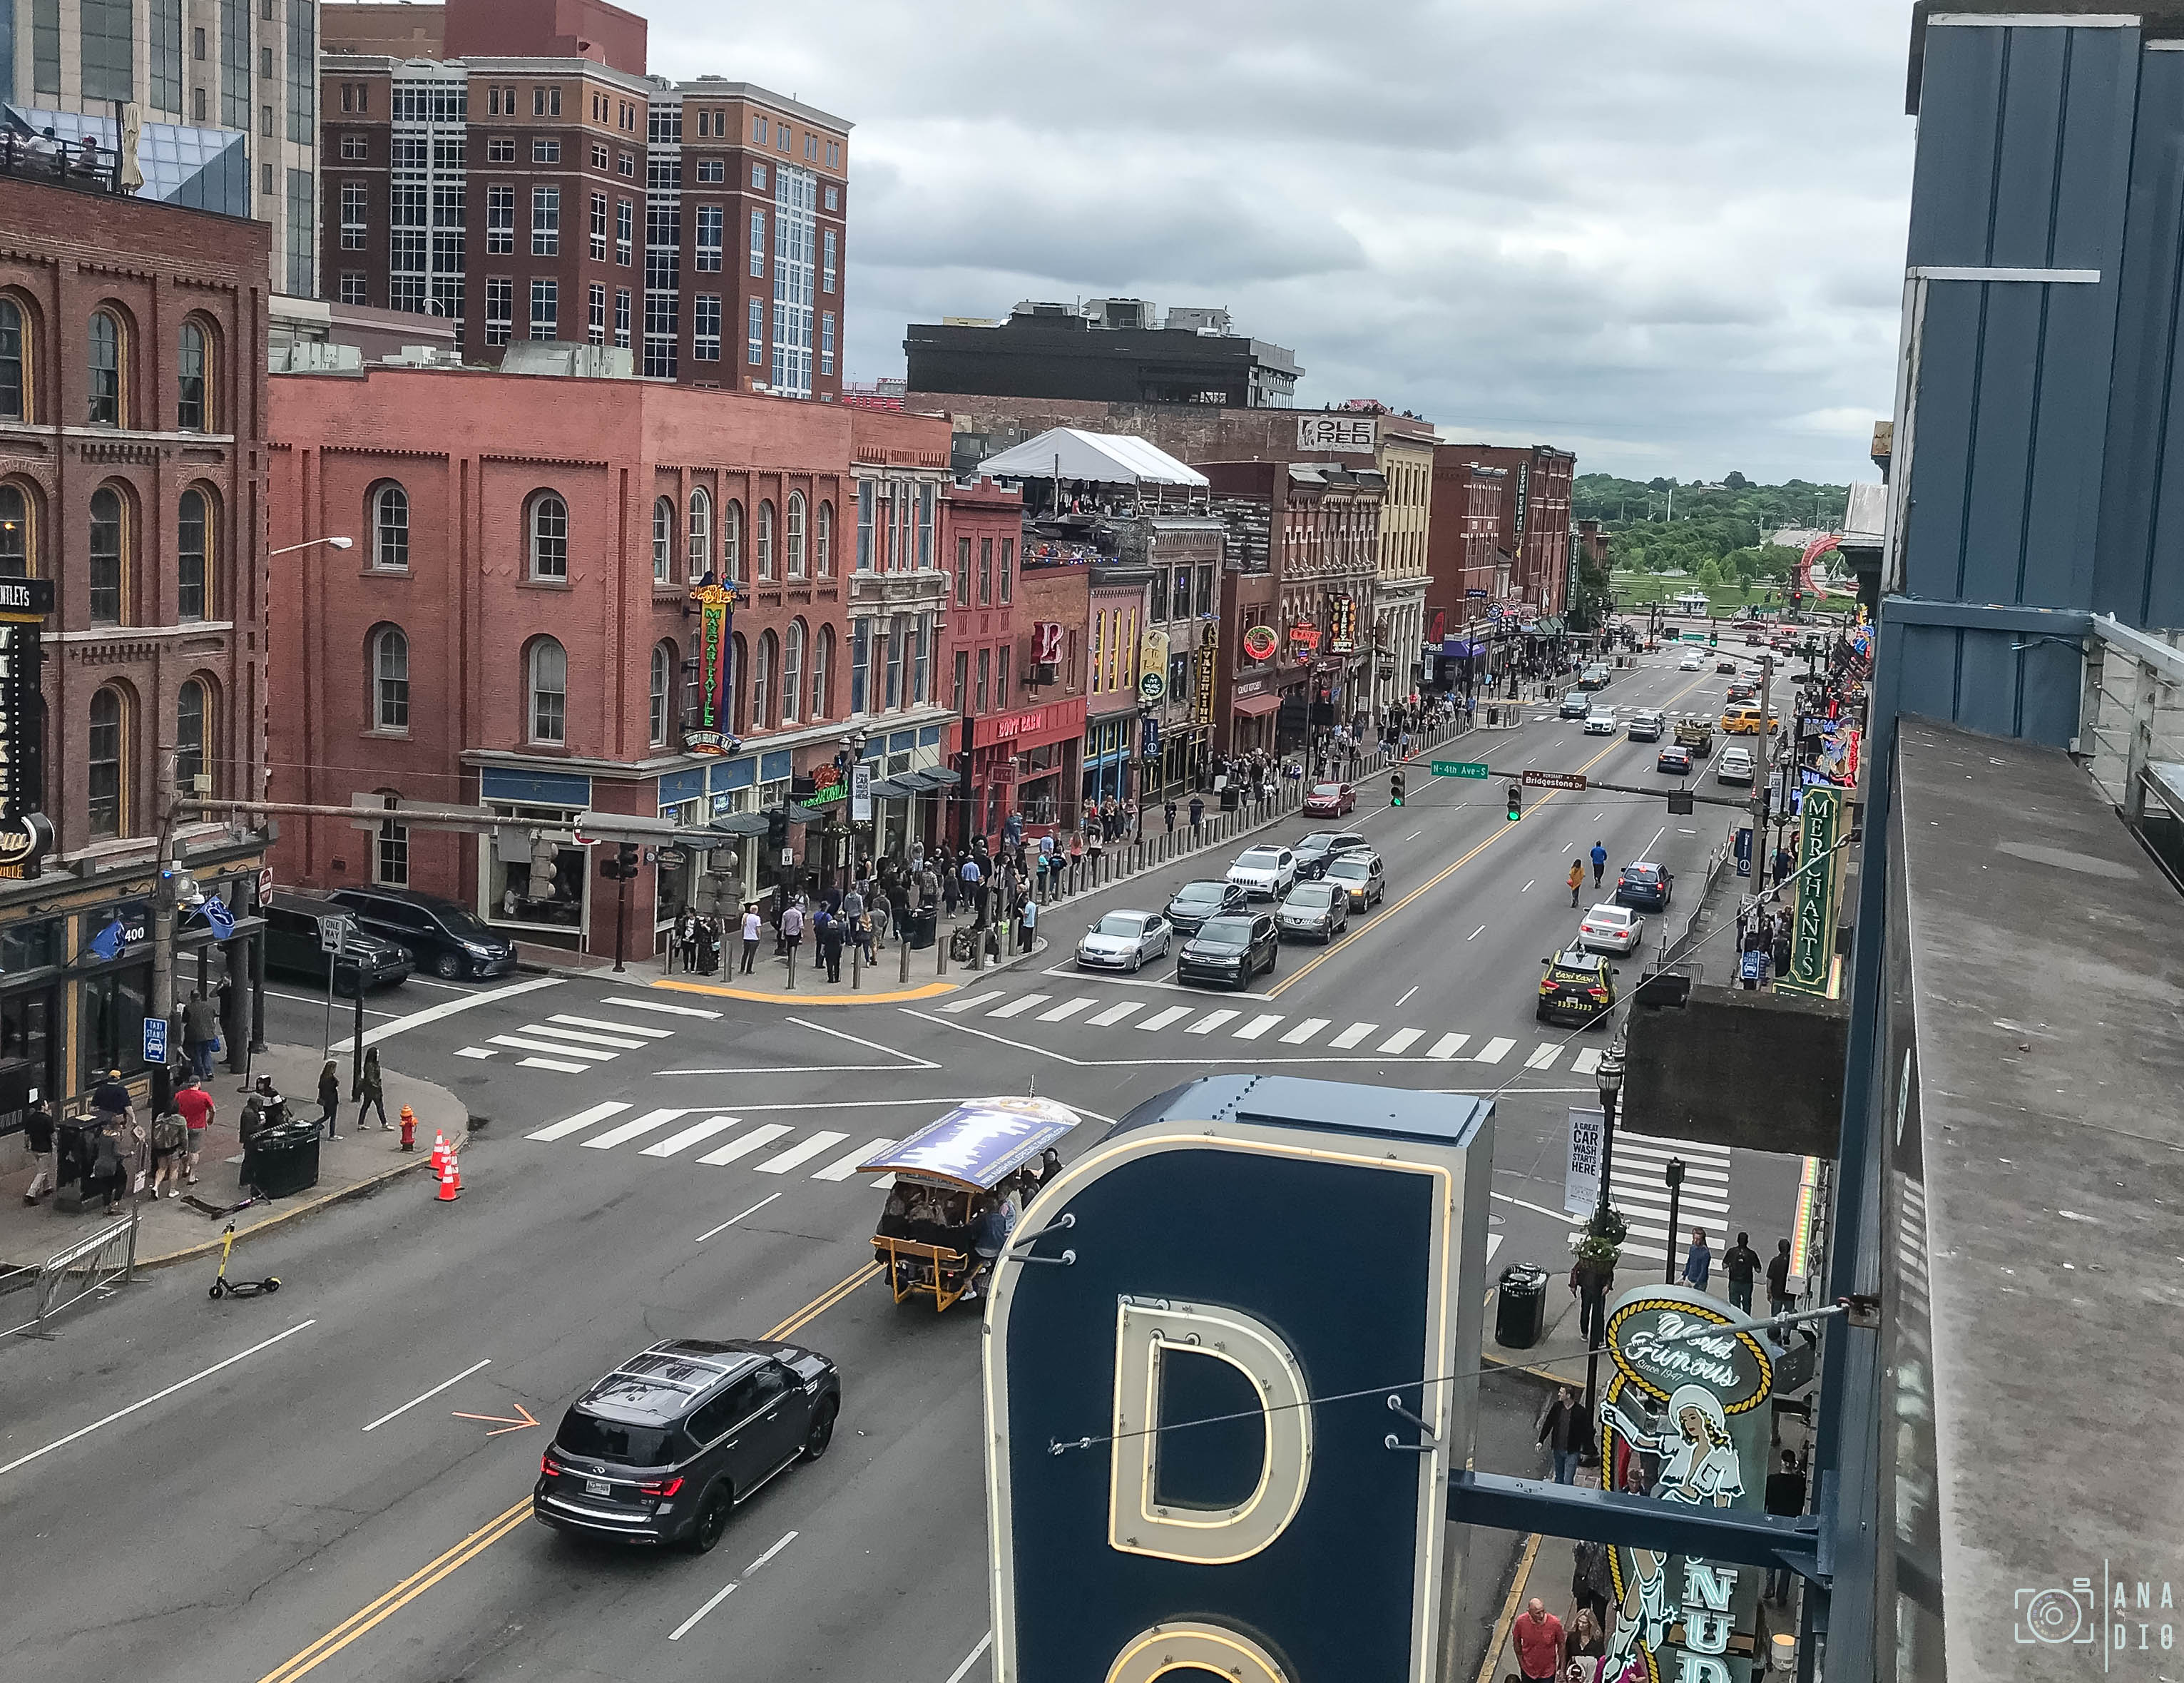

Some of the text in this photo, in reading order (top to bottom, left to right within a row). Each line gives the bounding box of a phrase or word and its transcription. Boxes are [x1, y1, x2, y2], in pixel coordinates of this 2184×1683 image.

[1317, 420, 1371, 433] OLE
[1317, 431, 1370, 444] RED
[1340, 599, 1349, 641] WHISKEY
[703, 609, 722, 727] MARGARITAVILLE
[1199, 651, 1212, 724] VALENTINE
[997, 717, 1020, 738] BOOT
[1526, 776, 1573, 788] Bridgestone
[1800, 796, 1830, 977] MERCHANTS
[124, 927, 145, 942] 400
[1555, 970, 1595, 982] taxi taxi
[149, 1020, 163, 1031] TAXI
[146, 1029, 164, 1039] STAND
[1579, 1122, 1599, 1132] GREAT
[1573, 1129, 1598, 1146] CAR
[1573, 1143, 1597, 1156] WASH
[1572, 1153, 1597, 1164] STARTS
[1571, 1161, 1596, 1176] HERE
[1625, 1331, 1741, 1387] Famous
[1635, 1359, 1684, 1381] Since 1947
